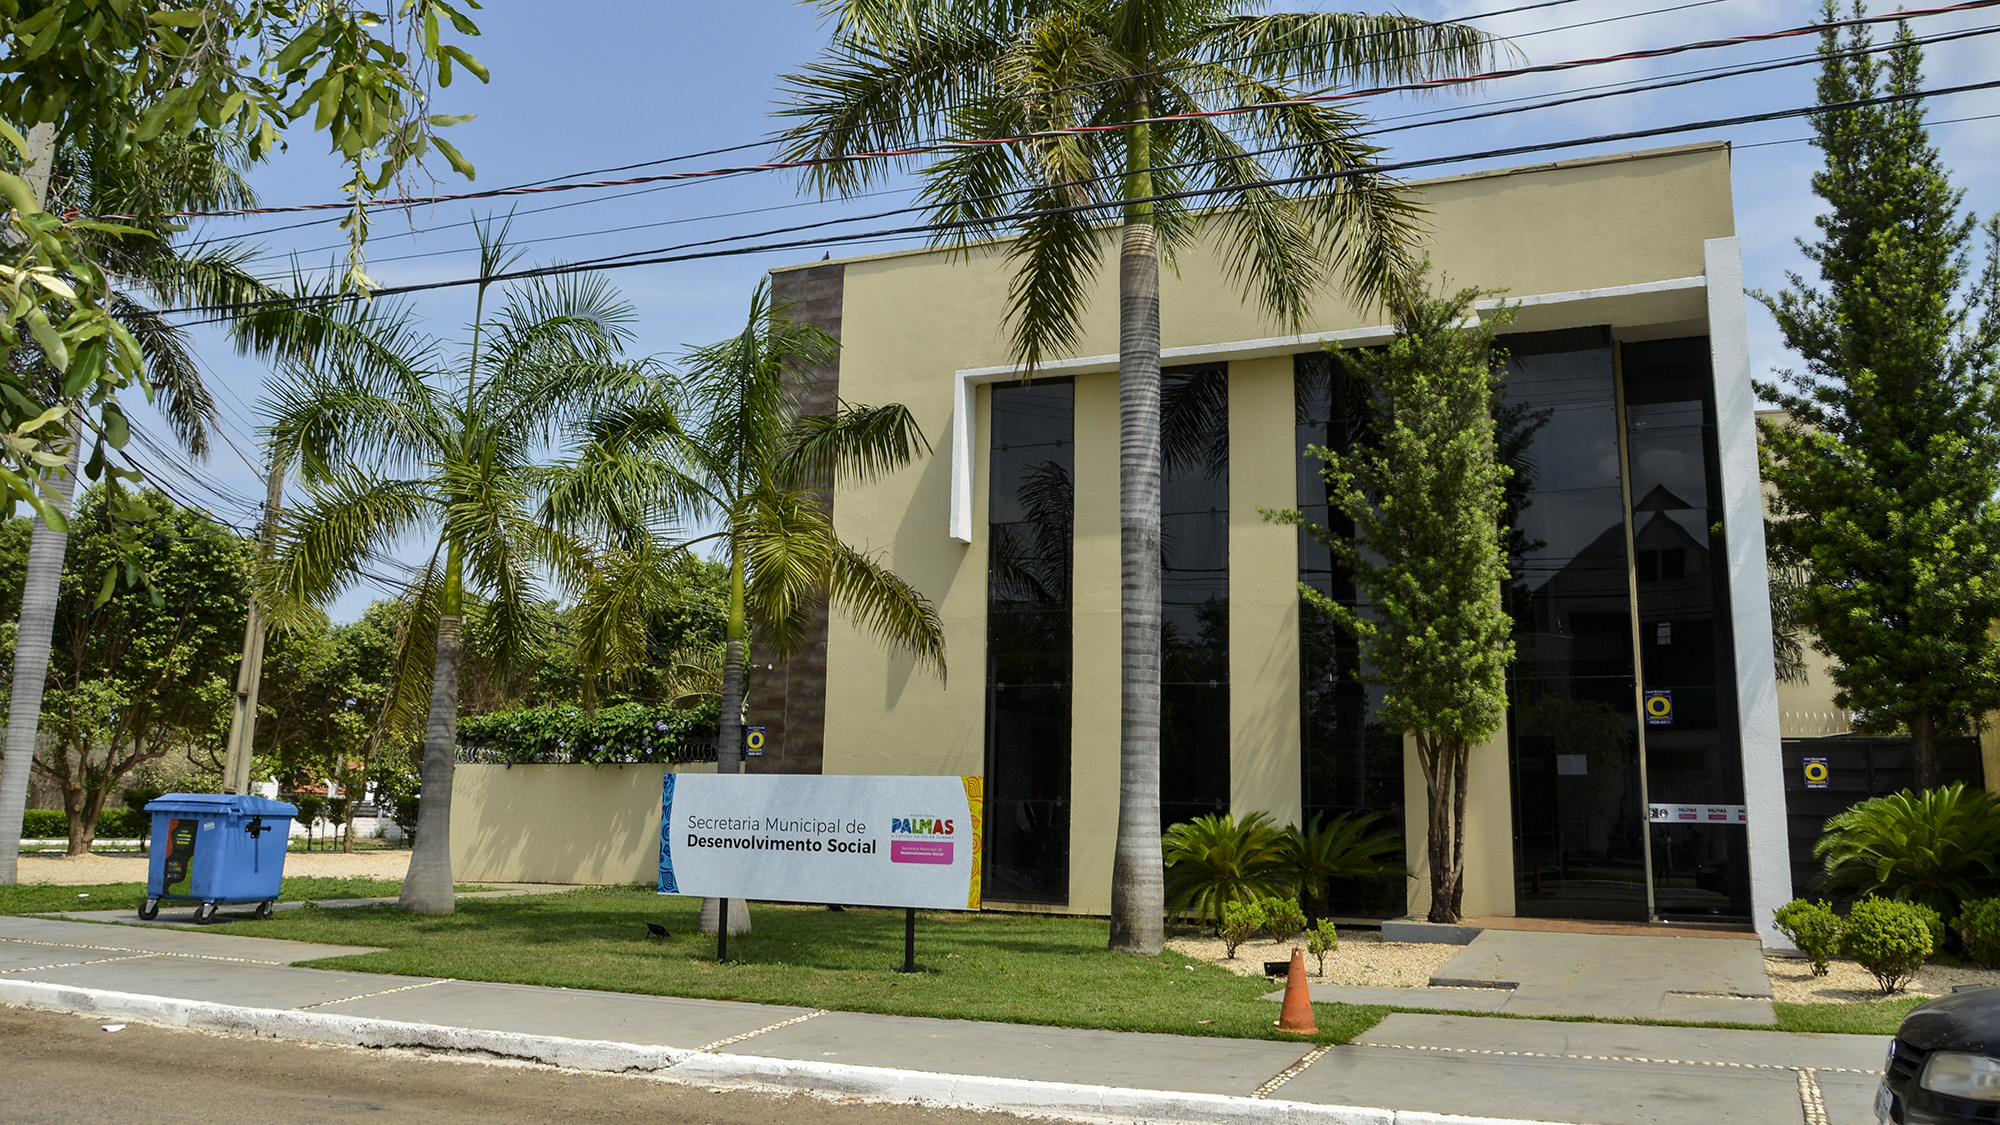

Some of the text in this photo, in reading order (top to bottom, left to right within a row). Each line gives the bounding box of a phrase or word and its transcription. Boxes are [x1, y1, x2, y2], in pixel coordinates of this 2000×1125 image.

[687, 815, 867, 836] Secretaria Municipal de
[891, 818, 954, 835] PALMAS
[687, 833, 877, 854] Desenvolvimento Social
